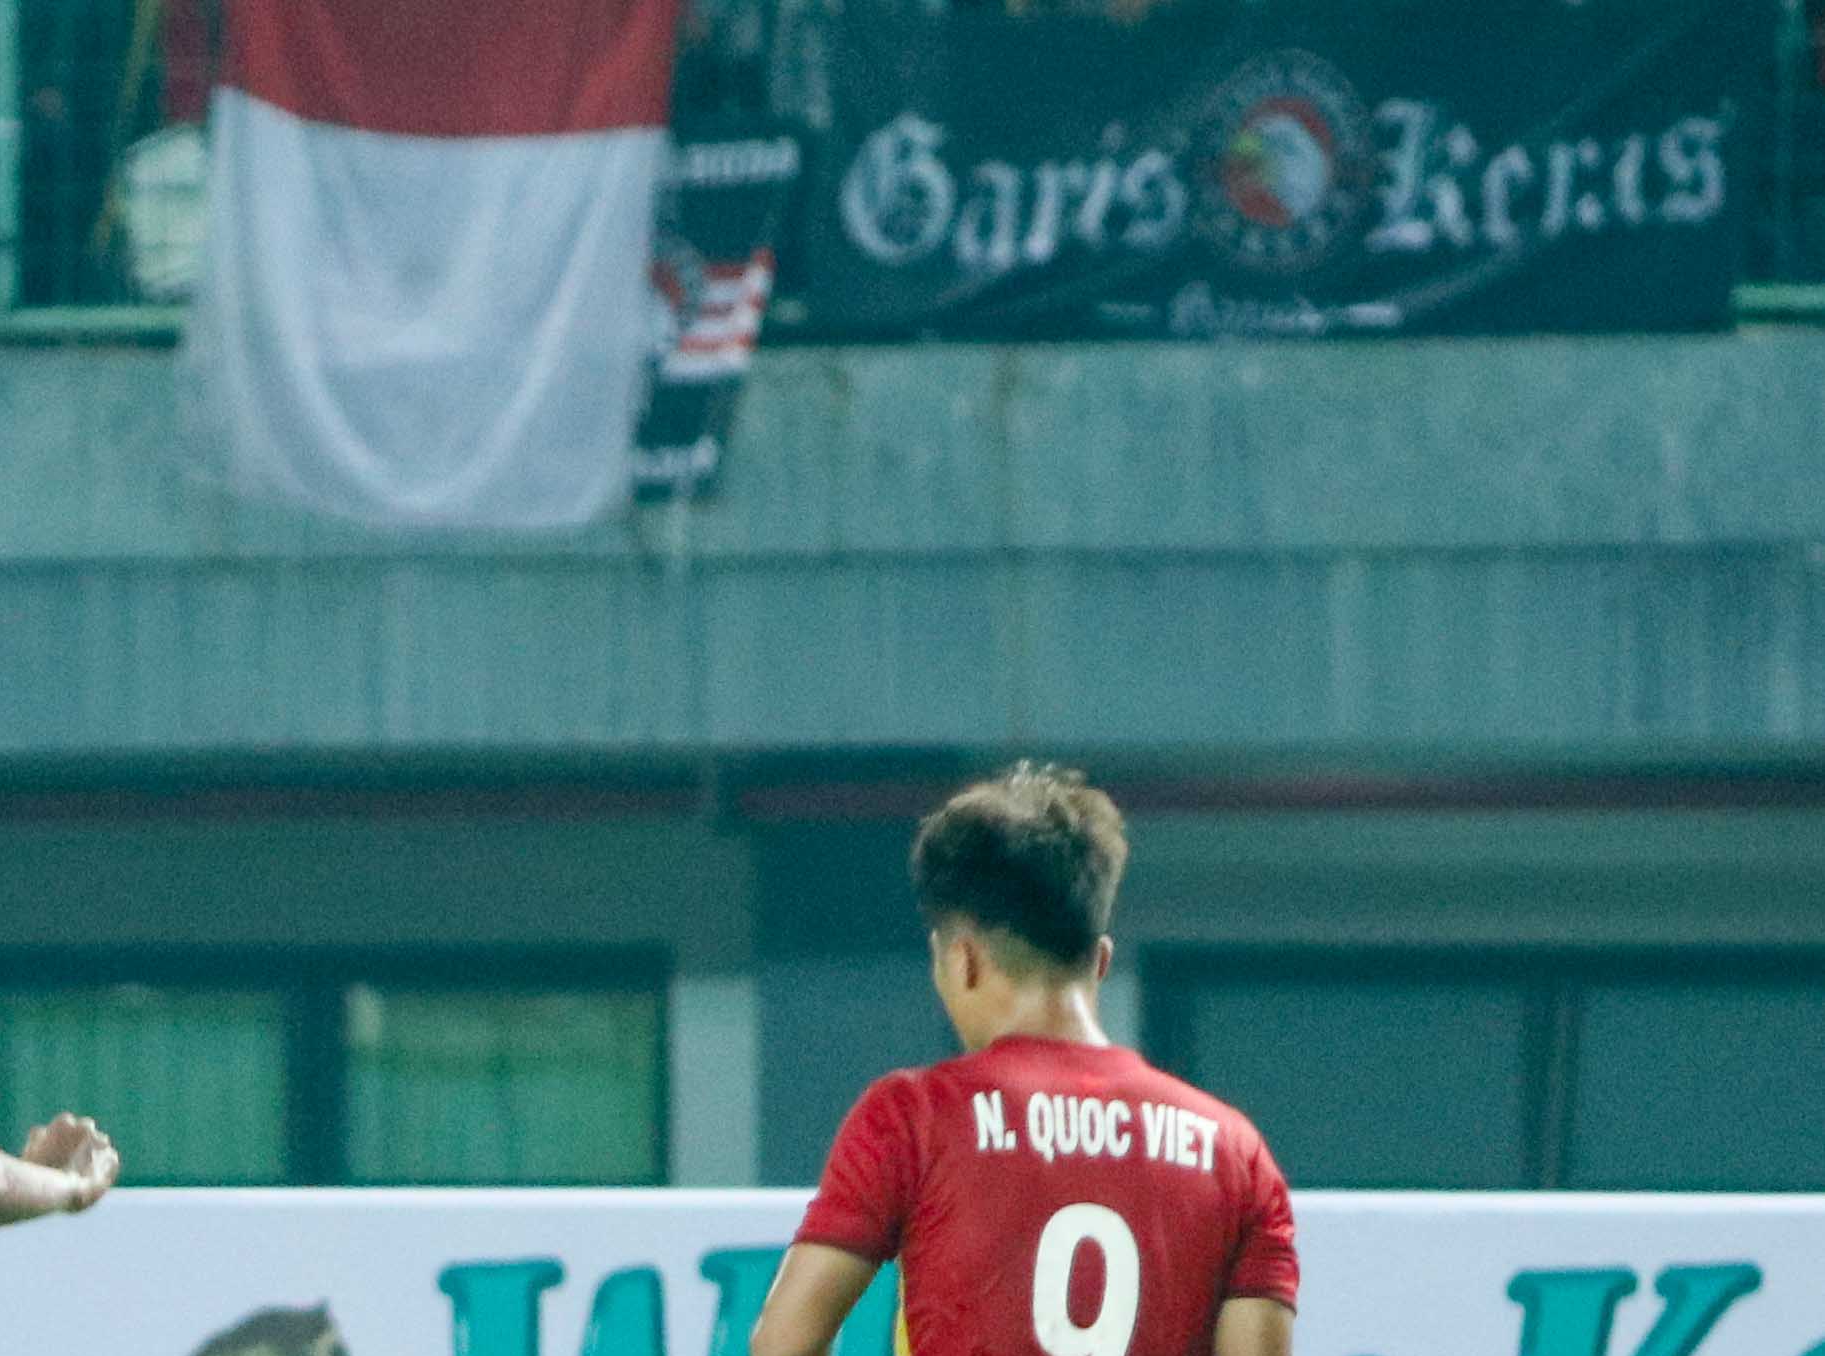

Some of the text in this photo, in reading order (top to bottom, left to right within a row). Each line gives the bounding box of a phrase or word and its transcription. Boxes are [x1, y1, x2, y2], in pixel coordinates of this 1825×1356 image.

[973, 1089, 1220, 1172] N. QUOC VIET
